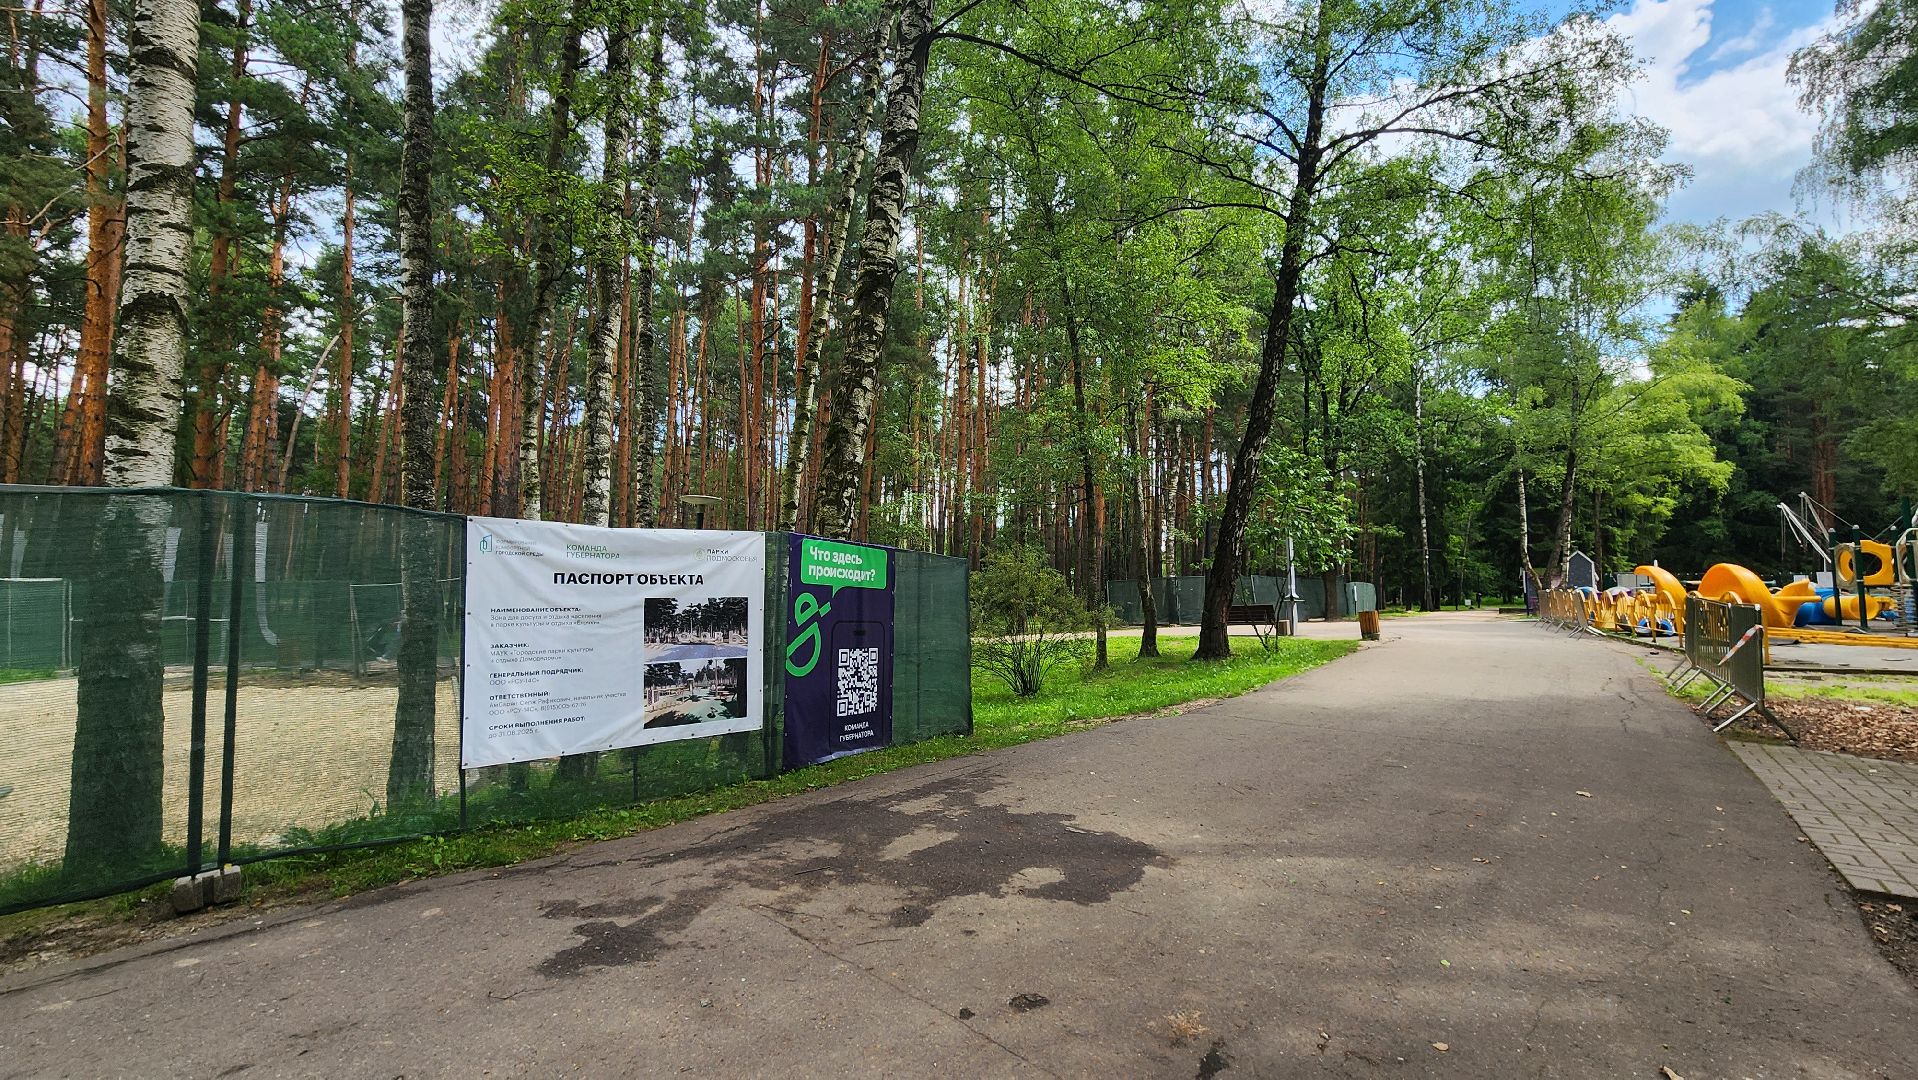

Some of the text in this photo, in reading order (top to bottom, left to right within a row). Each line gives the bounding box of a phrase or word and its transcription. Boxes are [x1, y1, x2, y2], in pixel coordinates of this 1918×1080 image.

[566, 544, 607, 552] КОМАНДА
[566, 552, 620, 560] ГУБЕРНАТОРА
[809, 545, 863, 565] Что здесь
[808, 564, 876, 582] происходит?
[553, 572, 704, 586] ПАСПОРТ ОБЪЕКТА
[489, 668, 584, 679] ГЕНЕРАЛЬНЫЙ ПОДРЯДЧИК:
[488, 723, 514, 731] СРОКИ
[844, 721, 869, 731] КОМАНДА
[839, 729, 875, 742] ГУБЕРНАТОРА
